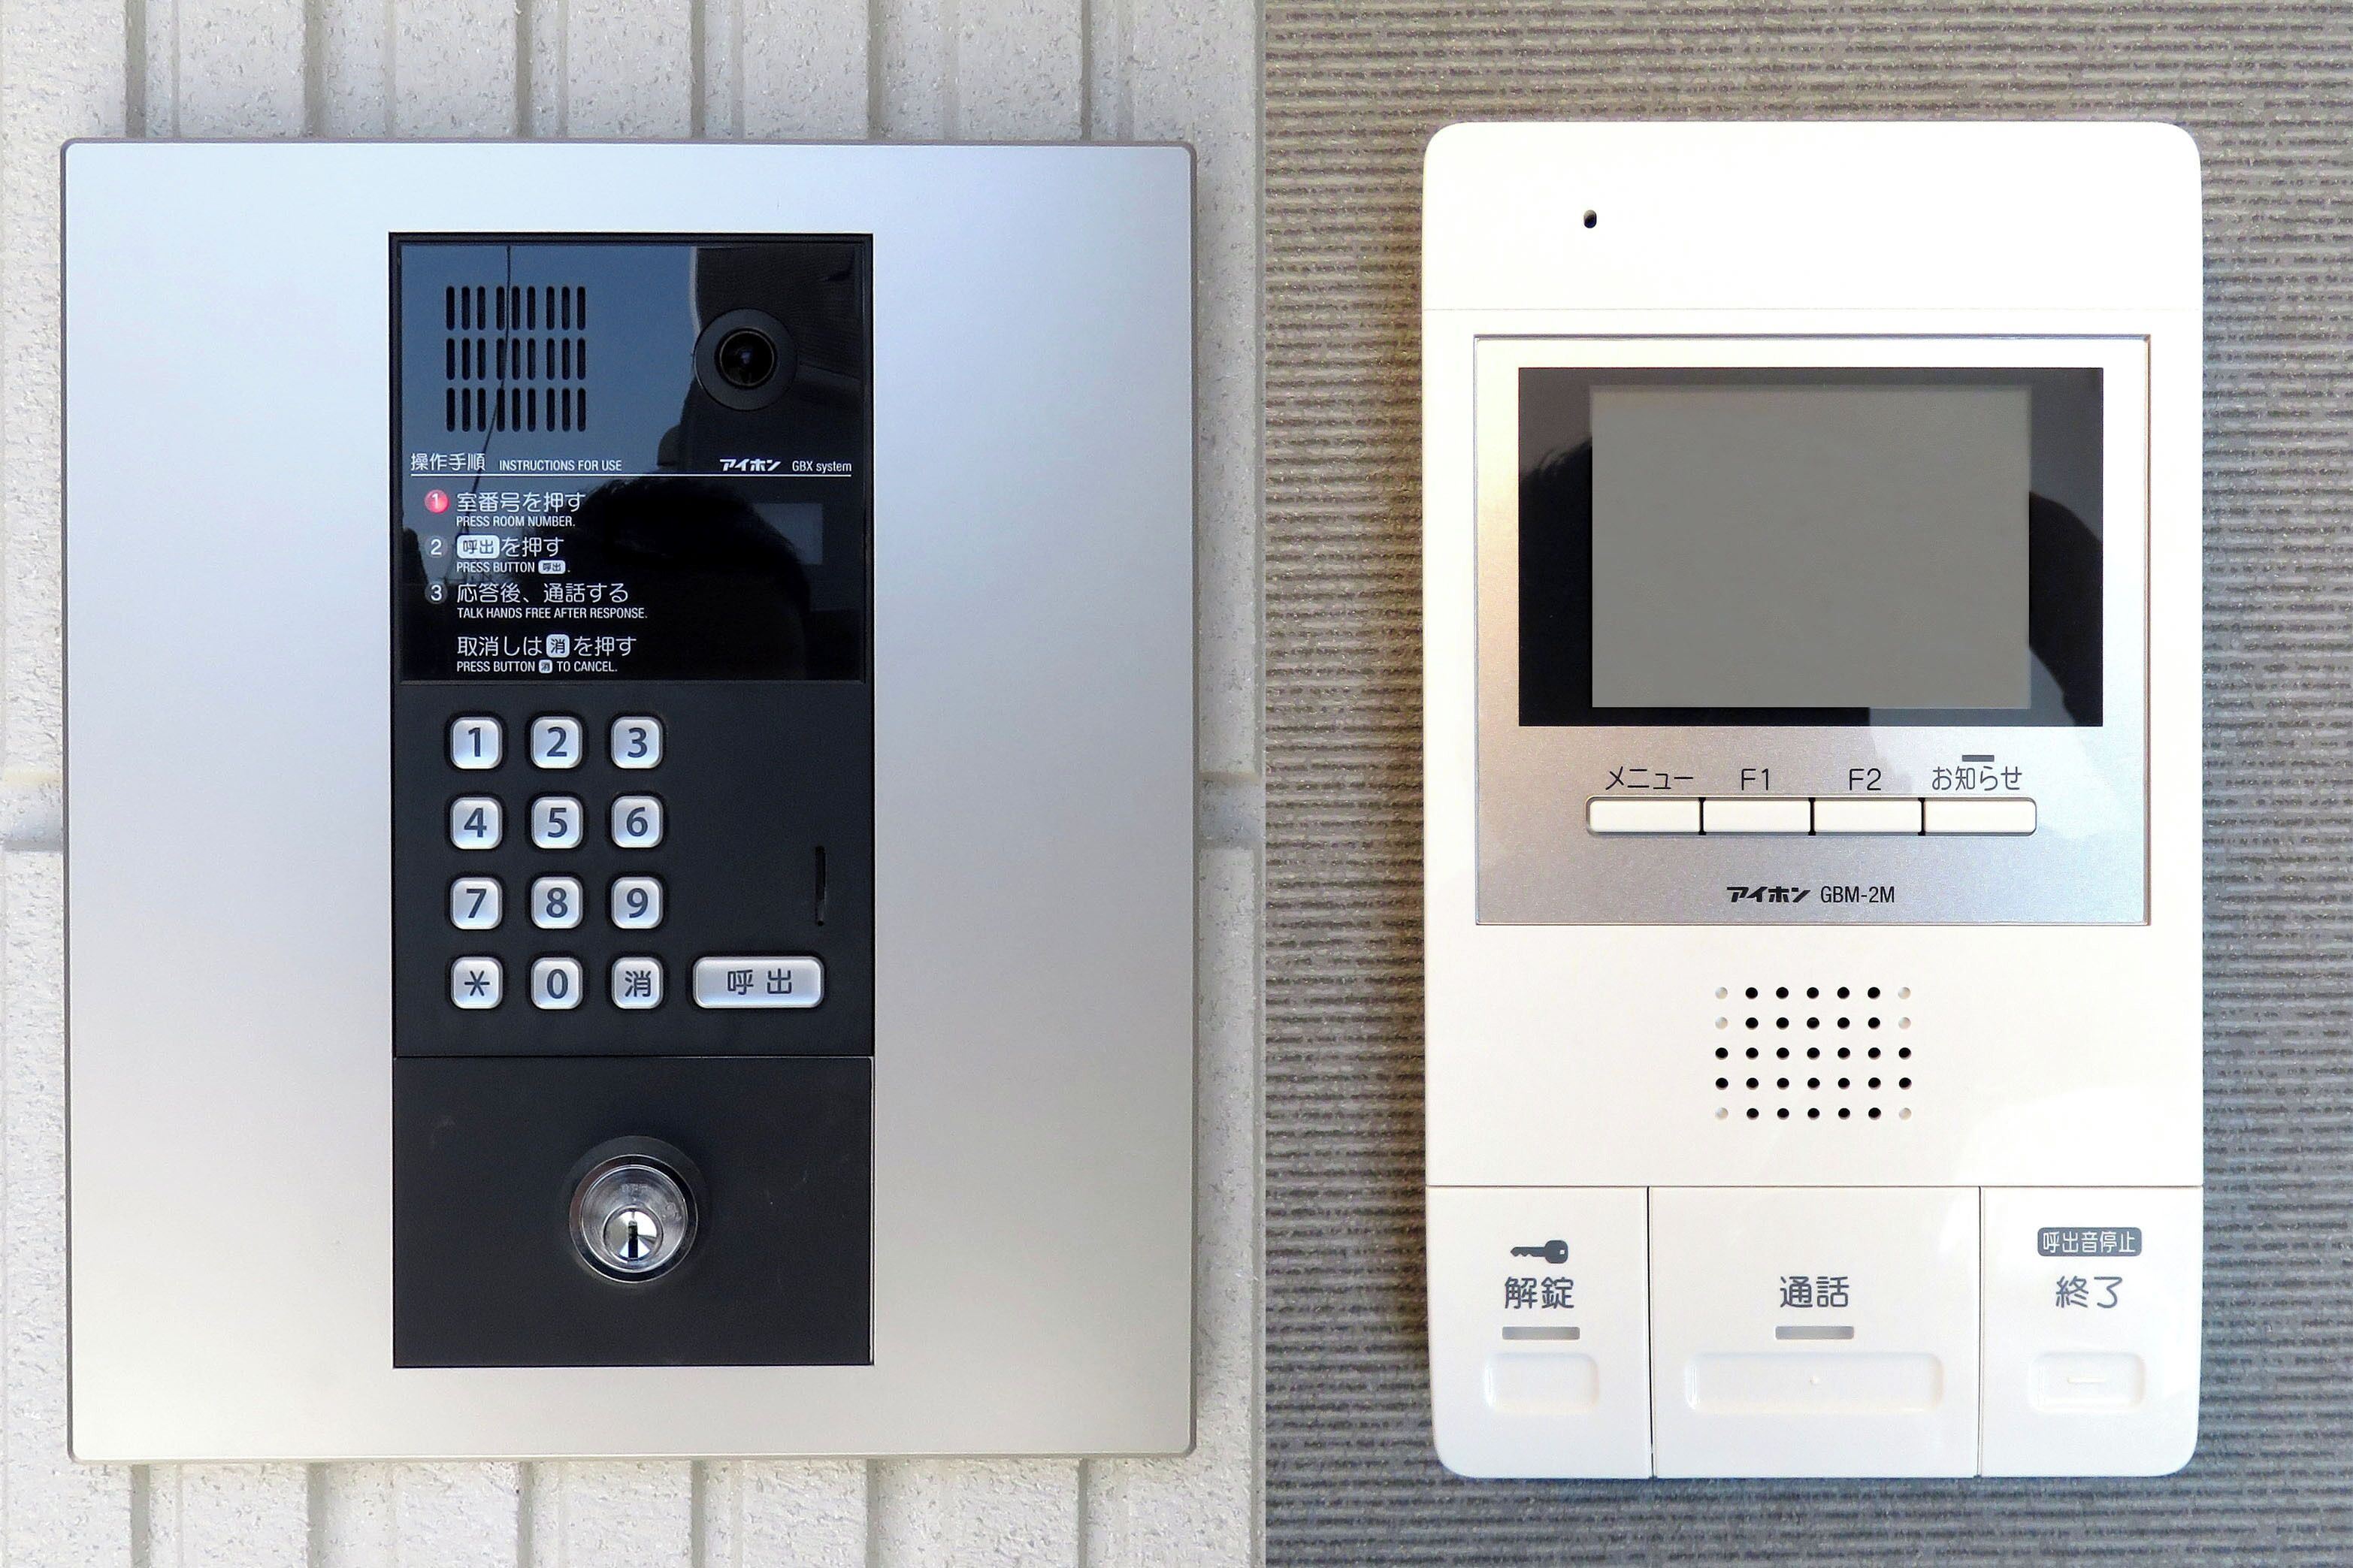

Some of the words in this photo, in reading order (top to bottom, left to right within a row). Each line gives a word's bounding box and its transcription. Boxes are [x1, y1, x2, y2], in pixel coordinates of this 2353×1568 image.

[410, 453, 485, 471] 操作手順
[499, 460, 575, 471] INSTRUCTIONS
[578, 460, 600, 471] FOR
[601, 460, 622, 471] USE
[719, 458, 782, 472] アイホン
[792, 461, 813, 472] GBX
[816, 461, 852, 473] system
[457, 491, 585, 512] 室番号を押す
[456, 516, 490, 527] PRESS
[493, 516, 525, 527] ROOM
[528, 516, 576, 527] NUMBER.
[430, 539, 442, 556] 2
[456, 562, 489, 573] PRESS
[493, 562, 535, 573] BUTTON
[430, 585, 442, 601] 3
[457, 583, 628, 603] 応答後、通話する
[457, 608, 483, 618] TALK
[486, 608, 522, 618] HANDS
[526, 608, 551, 618] FREE
[553, 608, 587, 618] AFTER
[590, 608, 648, 618] RESPONSE.
[456, 661, 490, 672] PRESS
[493, 661, 535, 672] BUTTON
[557, 661, 570, 672] TO
[573, 661, 618, 672] CANCEL.
[467, 727, 482, 757] 1
[546, 727, 568, 757] 2
[628, 727, 647, 757] 3
[1606, 766, 1693, 790] メニュー
[1741, 769, 1768, 790] F1
[1849, 769, 1881, 790] F2
[1932, 766, 2022, 790] お知らせ
[464, 808, 487, 837] 4
[548, 808, 567, 838] 5
[627, 807, 648, 836] 6
[466, 888, 488, 919] 7
[546, 887, 567, 917] 8
[627, 888, 648, 918] 9
[1727, 887, 1810, 902] アイホン
[1821, 886, 1894, 902] GBM-2M
[546, 968, 569, 999] 0
[625, 971, 651, 997] 消
[727, 968, 791, 995] 呼出
[2043, 1231, 2136, 1253] 呼出音停止
[1505, 1276, 1574, 1309] 解錠
[1780, 1276, 1849, 1308] 通話
[2055, 1276, 2122, 1308] 終了
